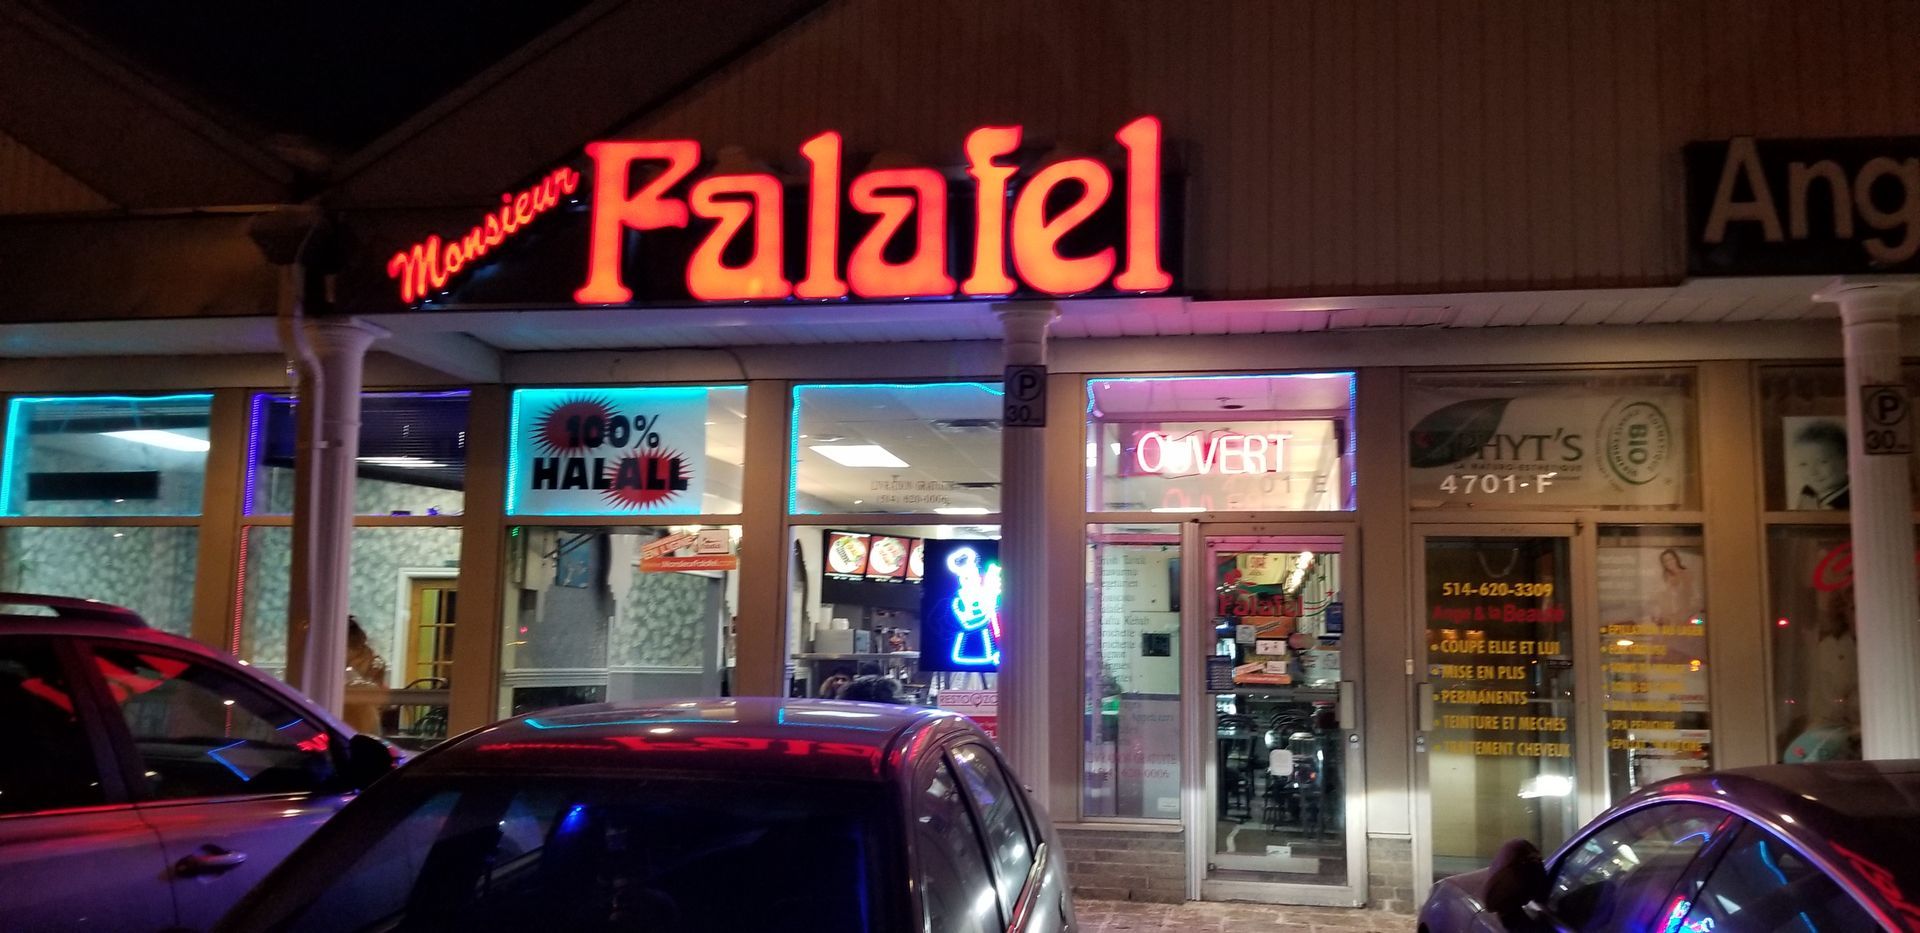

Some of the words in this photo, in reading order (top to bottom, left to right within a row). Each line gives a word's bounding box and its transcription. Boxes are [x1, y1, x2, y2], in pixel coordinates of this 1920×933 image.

[573, 117, 1173, 304] Falafel
[1704, 136, 1920, 263] Ang
[387, 166, 580, 303] Monsieur
[566, 414, 660, 450] 100%
[1627, 424, 1649, 465] BIO
[1137, 432, 1293, 475] OUVERT
[531, 457, 688, 491] HALALL
[1442, 582, 1553, 597] 514-620-3309
[1218, 593, 1303, 617] Falafel
[1440, 640, 1485, 654] COUPE
[1488, 640, 1517, 654] ELLE
[1519, 641, 1535, 655] ET
[1537, 641, 1561, 655] LUI
[1441, 664, 1474, 678] MISE
[1476, 665, 1494, 679] EN
[1498, 666, 1526, 680] PLIS
[1441, 690, 1528, 704] PERMANENTS
[1442, 715, 1500, 730] TEINTURE
[1502, 716, 1516, 731] ET
[1517, 742, 1571, 757] CHEVEUX
